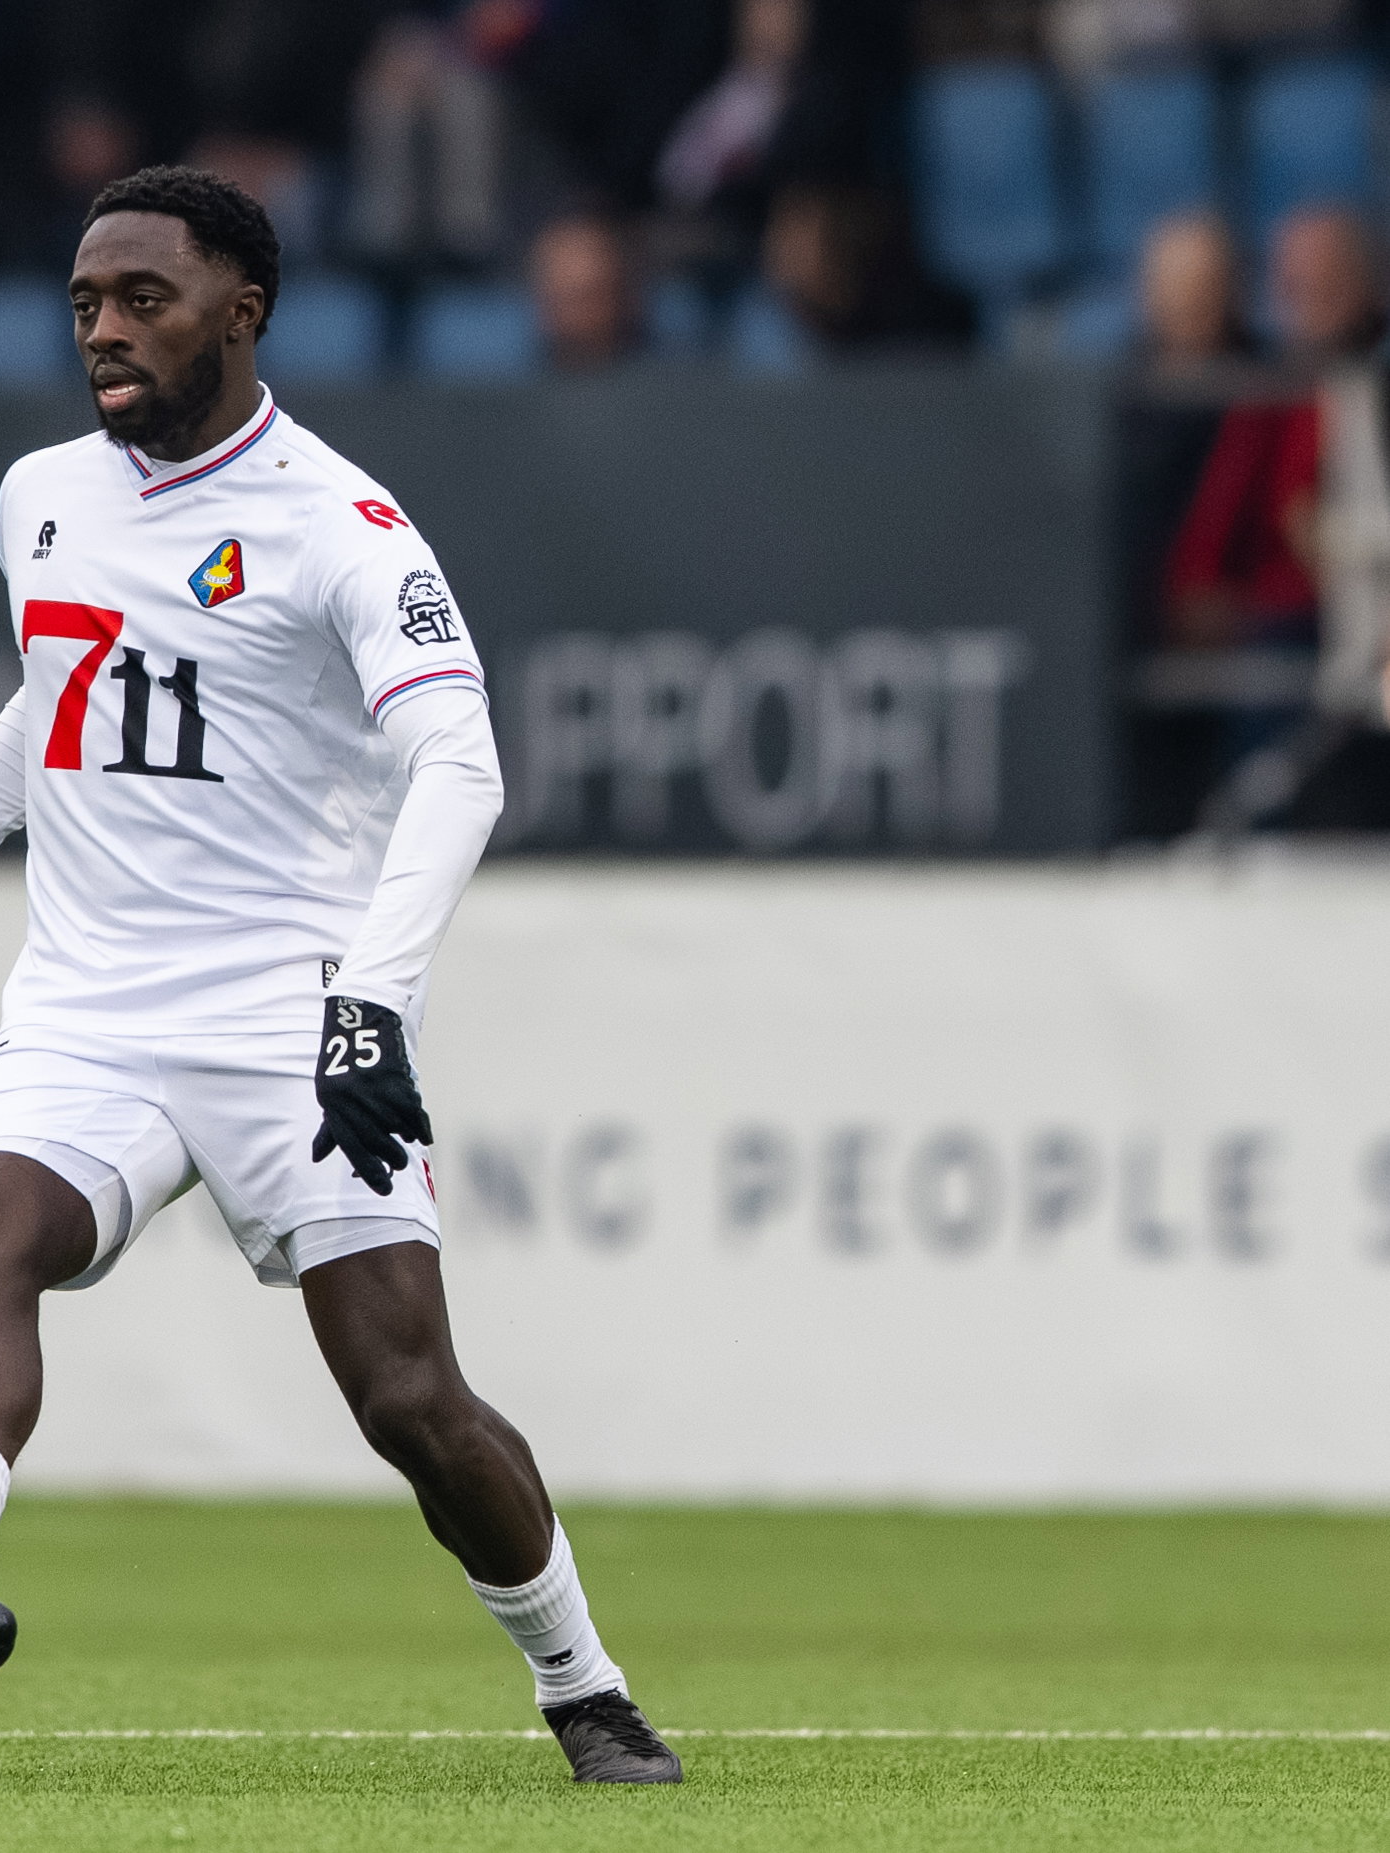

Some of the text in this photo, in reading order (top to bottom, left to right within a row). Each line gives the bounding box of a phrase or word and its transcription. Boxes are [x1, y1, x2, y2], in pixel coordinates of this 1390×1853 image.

[22, 599, 224, 783] 711
[510, 630, 1026, 842] PPORT
[324, 1028, 381, 1076] 25
[715, 1115, 1282, 1266] PEOPLE
